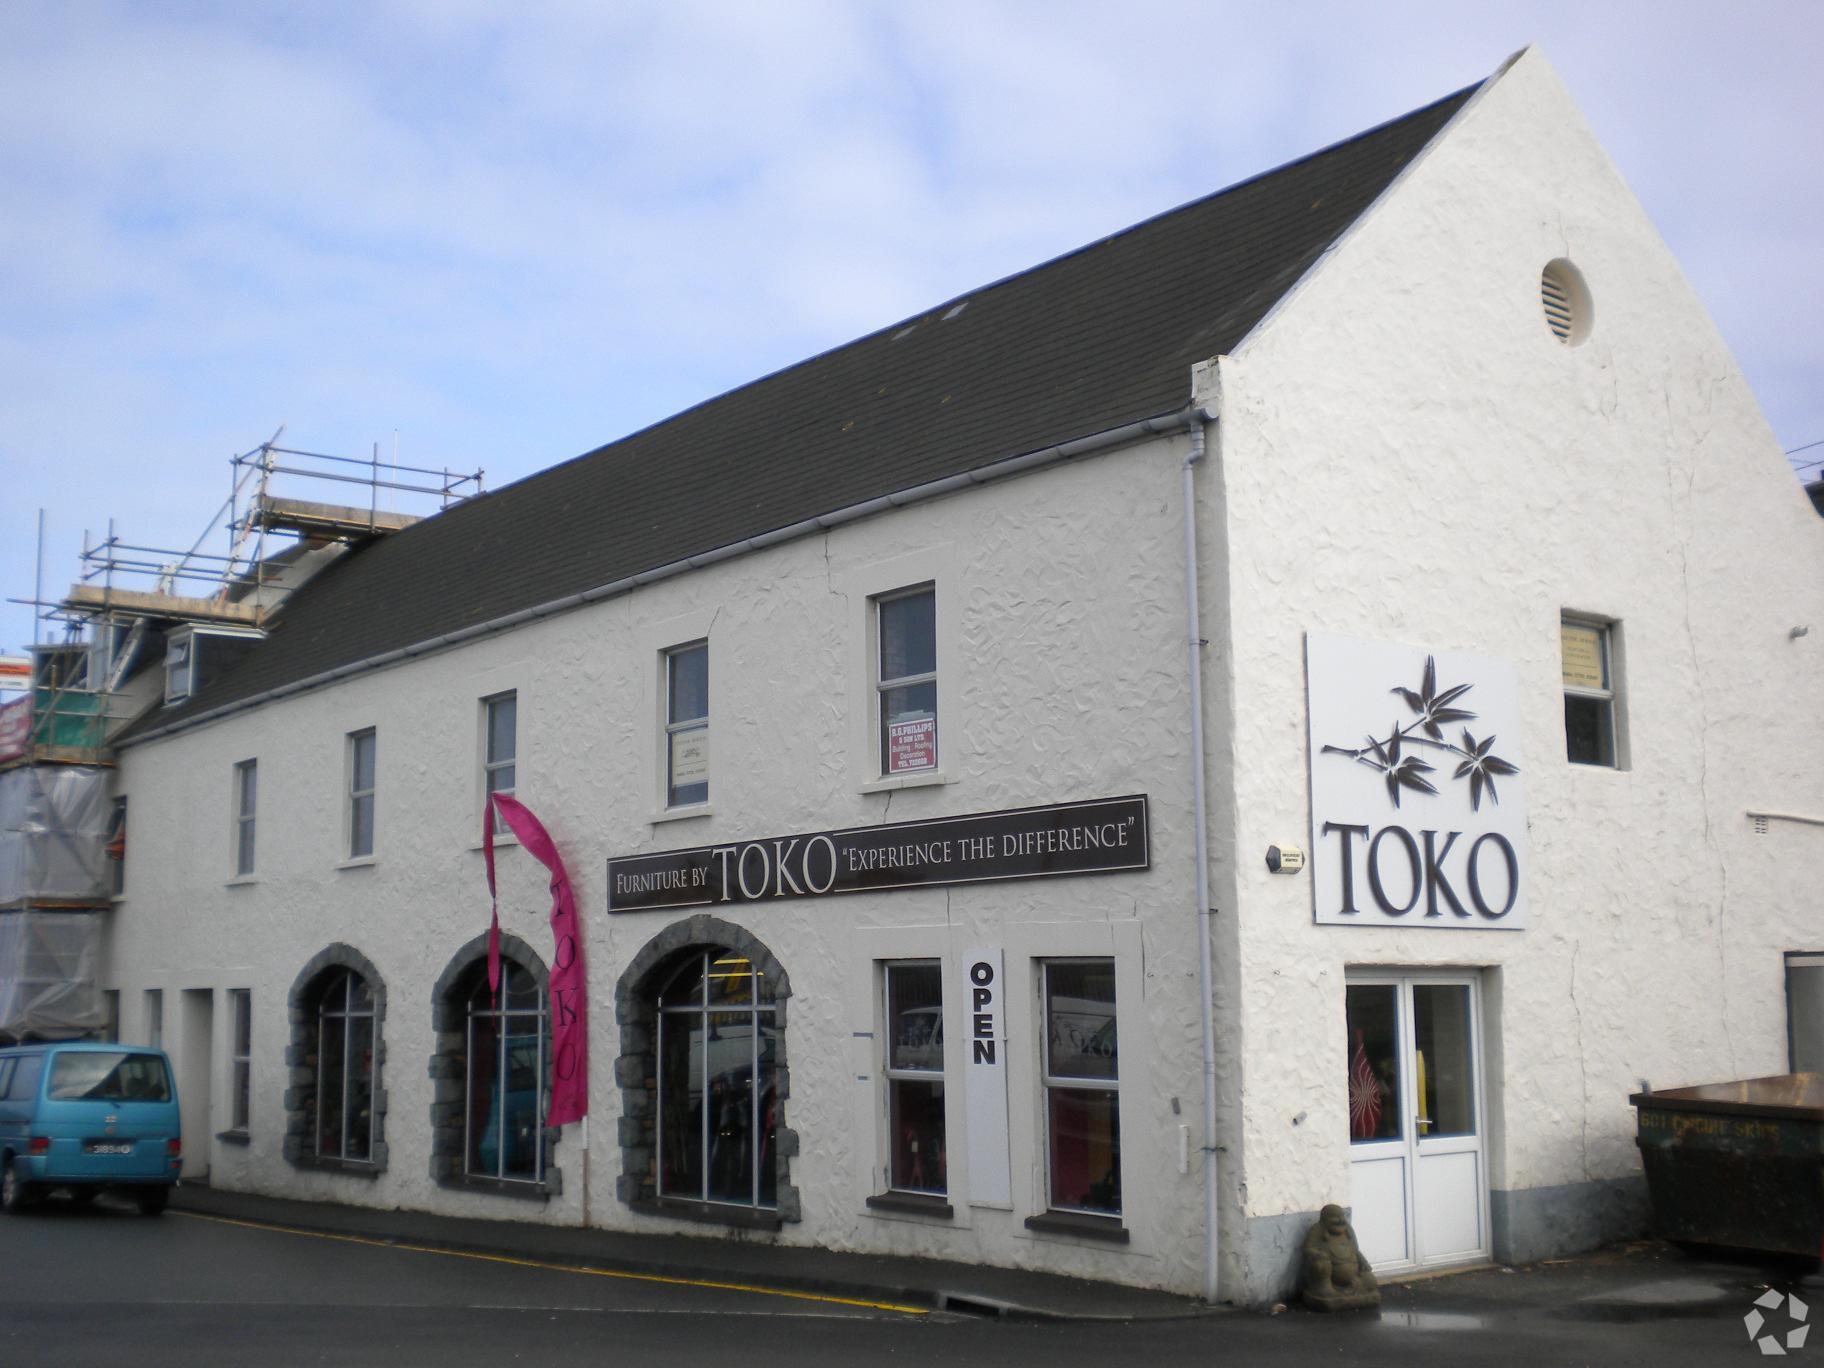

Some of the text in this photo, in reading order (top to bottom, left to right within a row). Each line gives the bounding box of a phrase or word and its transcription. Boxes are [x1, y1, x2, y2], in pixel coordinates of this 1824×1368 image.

[914, 742, 932, 750] Roofing
[617, 868, 687, 894] FURNITURE
[692, 866, 708, 887] BY
[711, 835, 837, 901] TOKO
[957, 836, 995, 861] THE
[1320, 820, 1519, 920] TOKO
[550, 879, 578, 1081] TOKO
[970, 961, 996, 1065] OPEN
